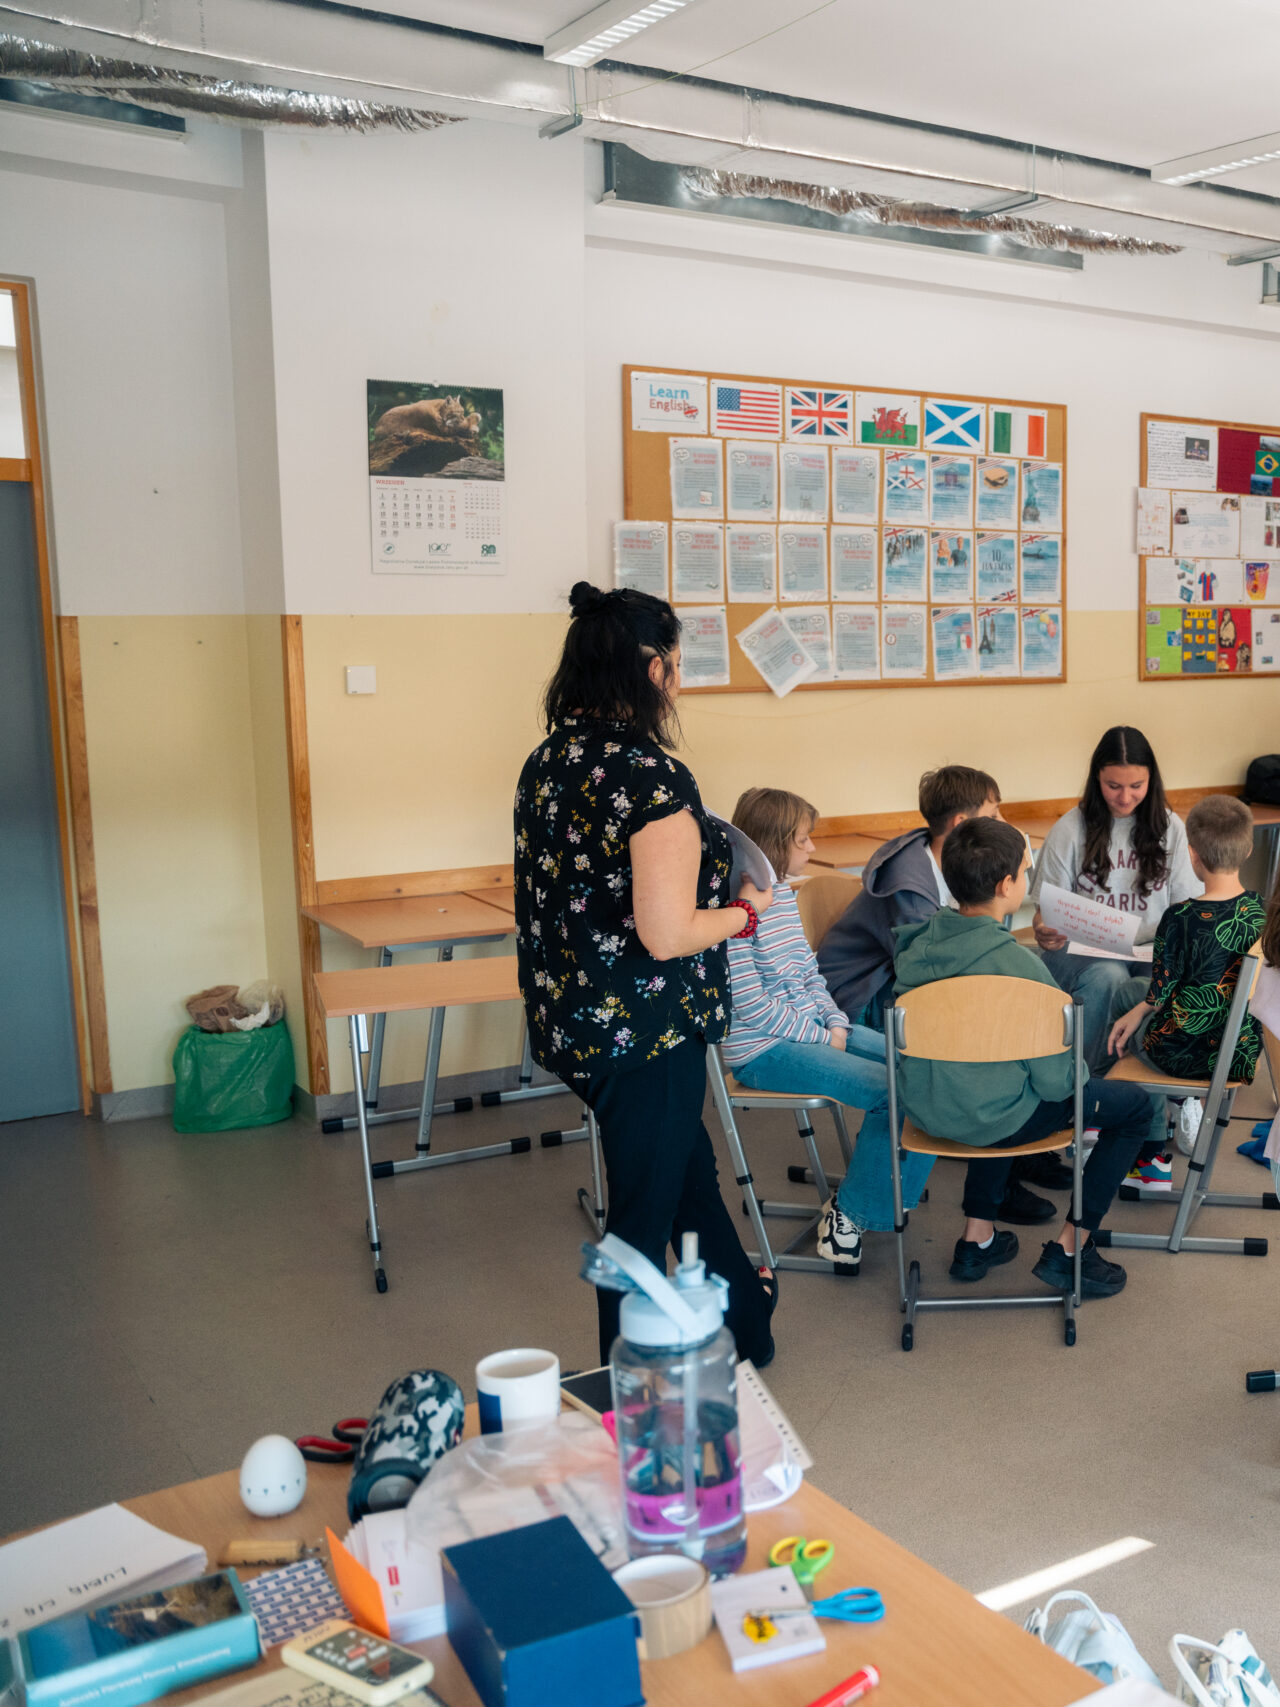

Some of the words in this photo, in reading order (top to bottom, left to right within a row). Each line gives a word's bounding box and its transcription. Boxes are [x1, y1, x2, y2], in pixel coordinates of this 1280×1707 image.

[650, 384, 690, 400] Learn
[650, 398, 690, 413] English
[992, 549, 1002, 561] 10
[1096, 893, 1148, 912] PARIS
